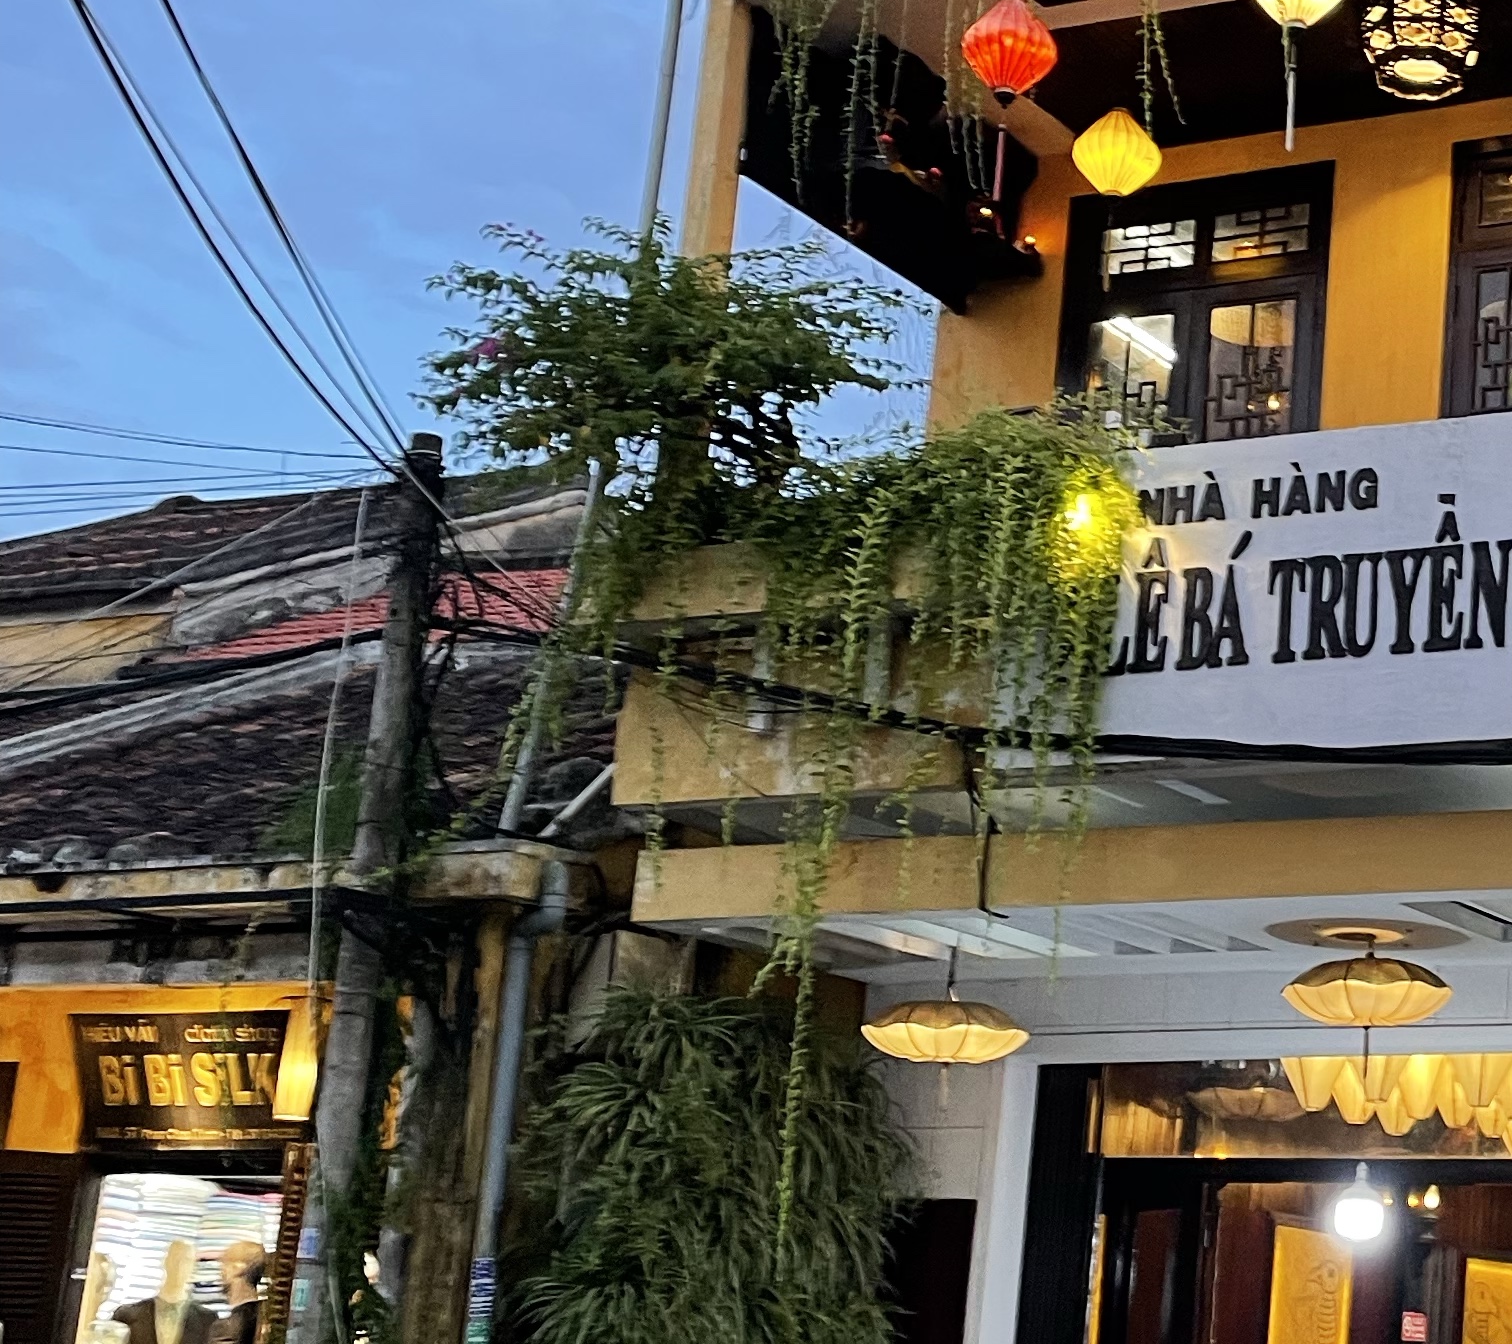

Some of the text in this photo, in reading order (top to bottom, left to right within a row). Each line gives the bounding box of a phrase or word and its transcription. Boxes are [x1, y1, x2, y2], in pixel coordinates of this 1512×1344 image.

[1138, 462, 1379, 525] NHÀ HÀNG
[1174, 530, 1253, 670] BÁ
[1267, 493, 1512, 663] TRUYỀN
